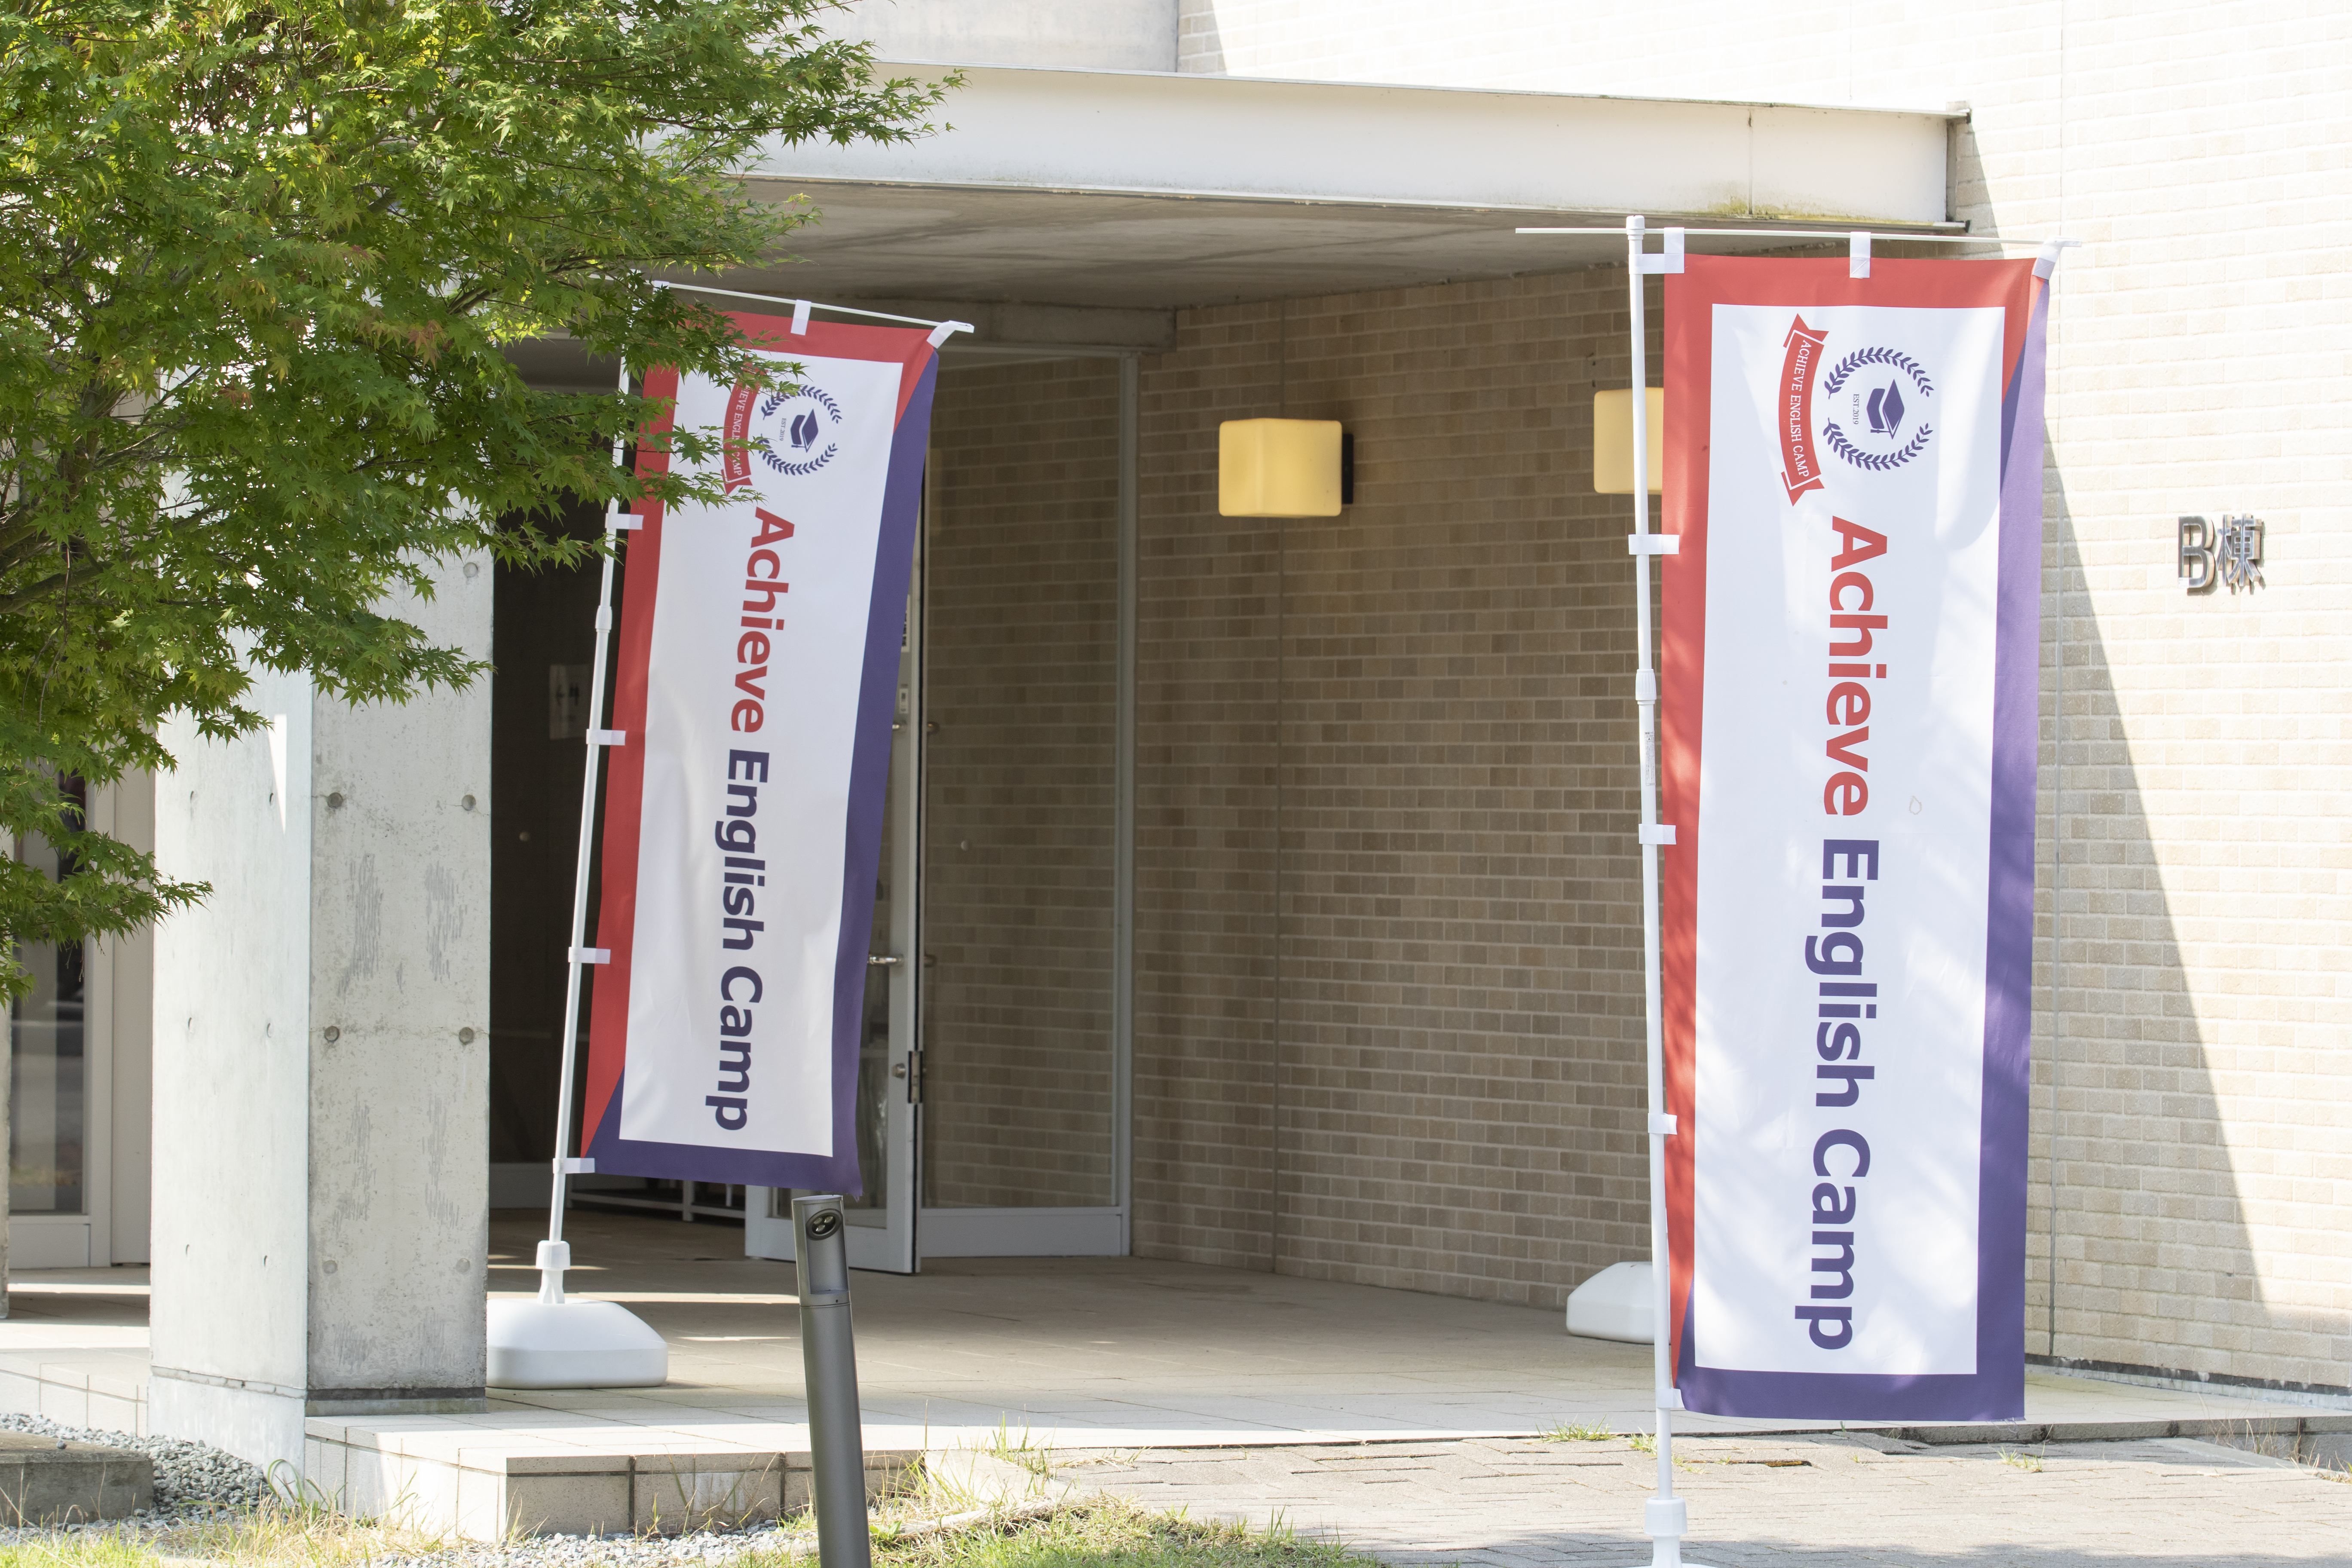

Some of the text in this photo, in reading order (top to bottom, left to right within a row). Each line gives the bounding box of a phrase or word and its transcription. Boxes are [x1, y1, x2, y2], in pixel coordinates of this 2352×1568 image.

[1790, 340, 1812, 477] ACHIEVE ENGLISH CAMP
[2178, 513, 2262, 588] B棟
[705, 507, 794, 1130] Achieve English Camp
[1795, 516, 1887, 1350] Achieve English Camp
